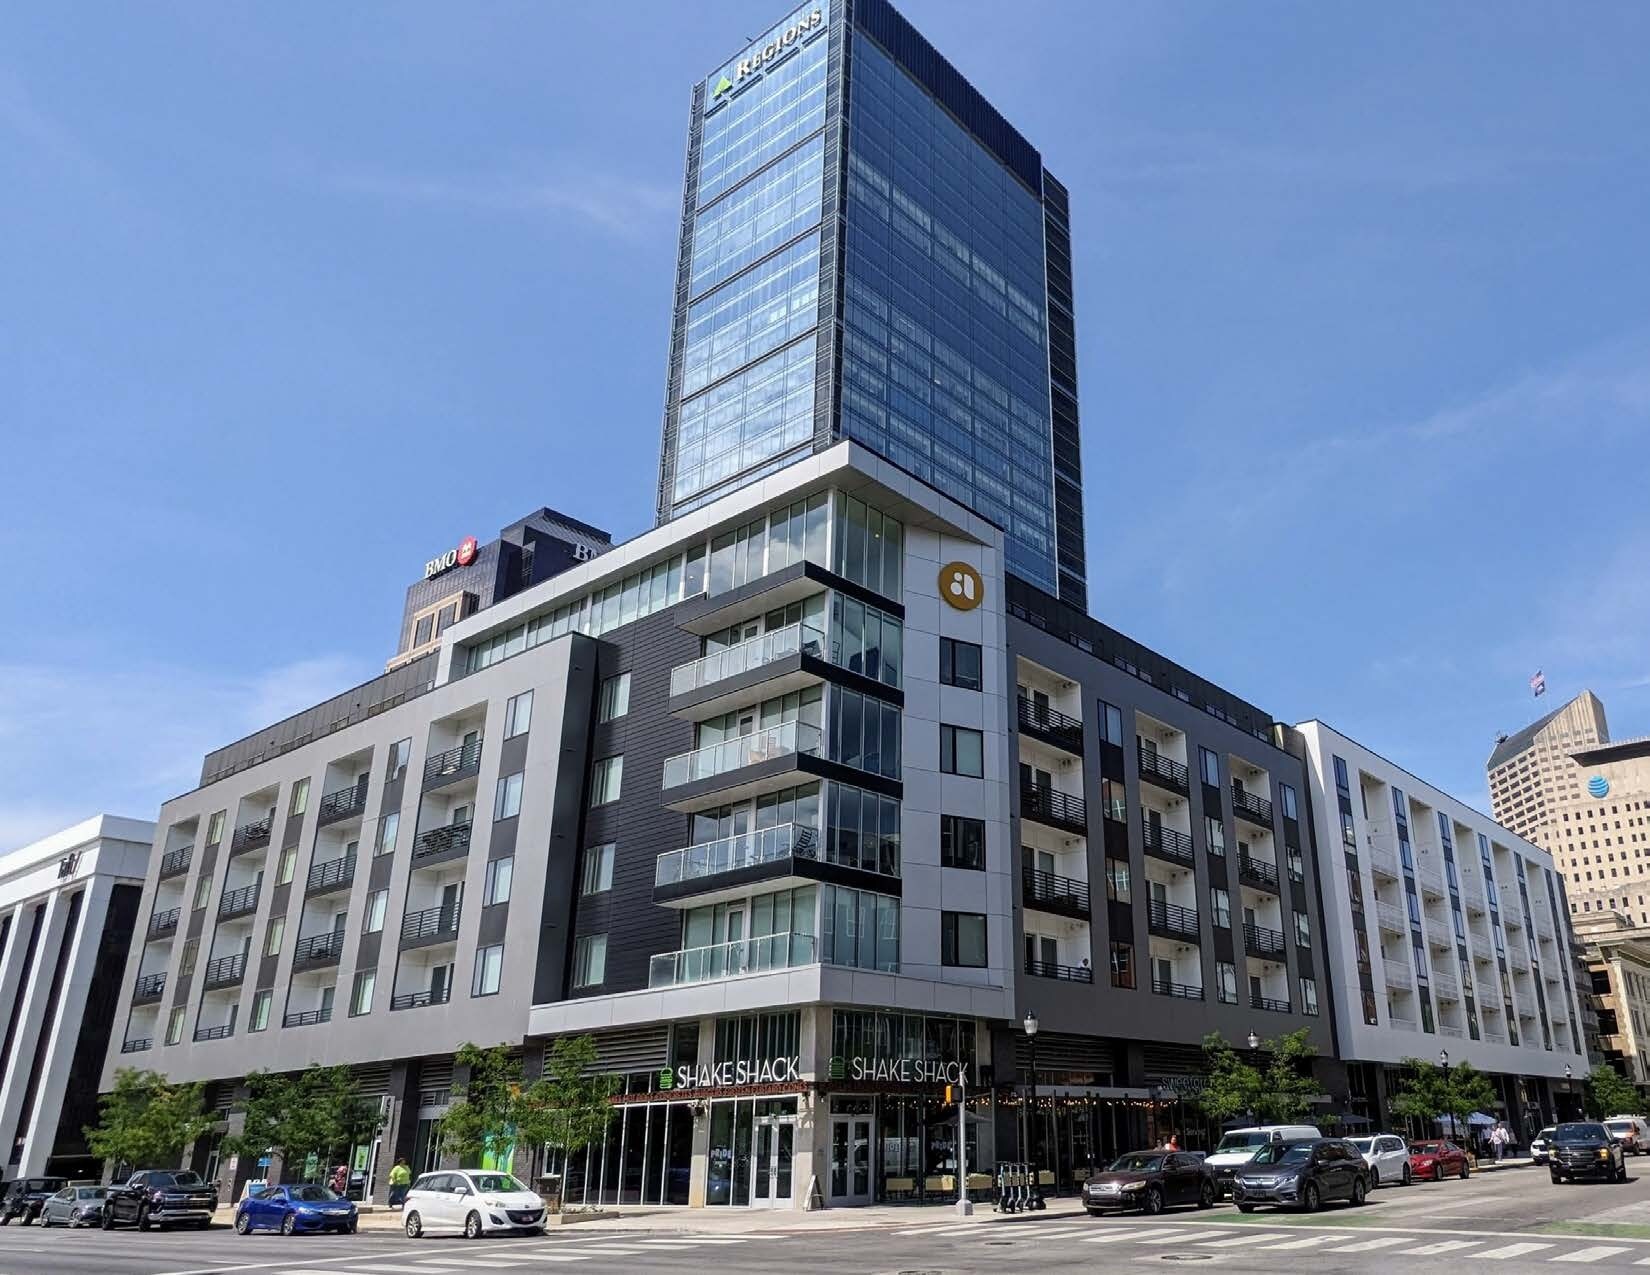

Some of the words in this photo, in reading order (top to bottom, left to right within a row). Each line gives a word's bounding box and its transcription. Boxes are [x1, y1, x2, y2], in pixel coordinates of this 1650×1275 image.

[735, 7, 822, 83] REGIONS
[425, 549, 457, 579] BMO
[676, 1061, 733, 1090] SHAKE
[735, 1055, 800, 1085] SHACK
[851, 1056, 911, 1082] SHAKE
[914, 1060, 969, 1083] SHACK
